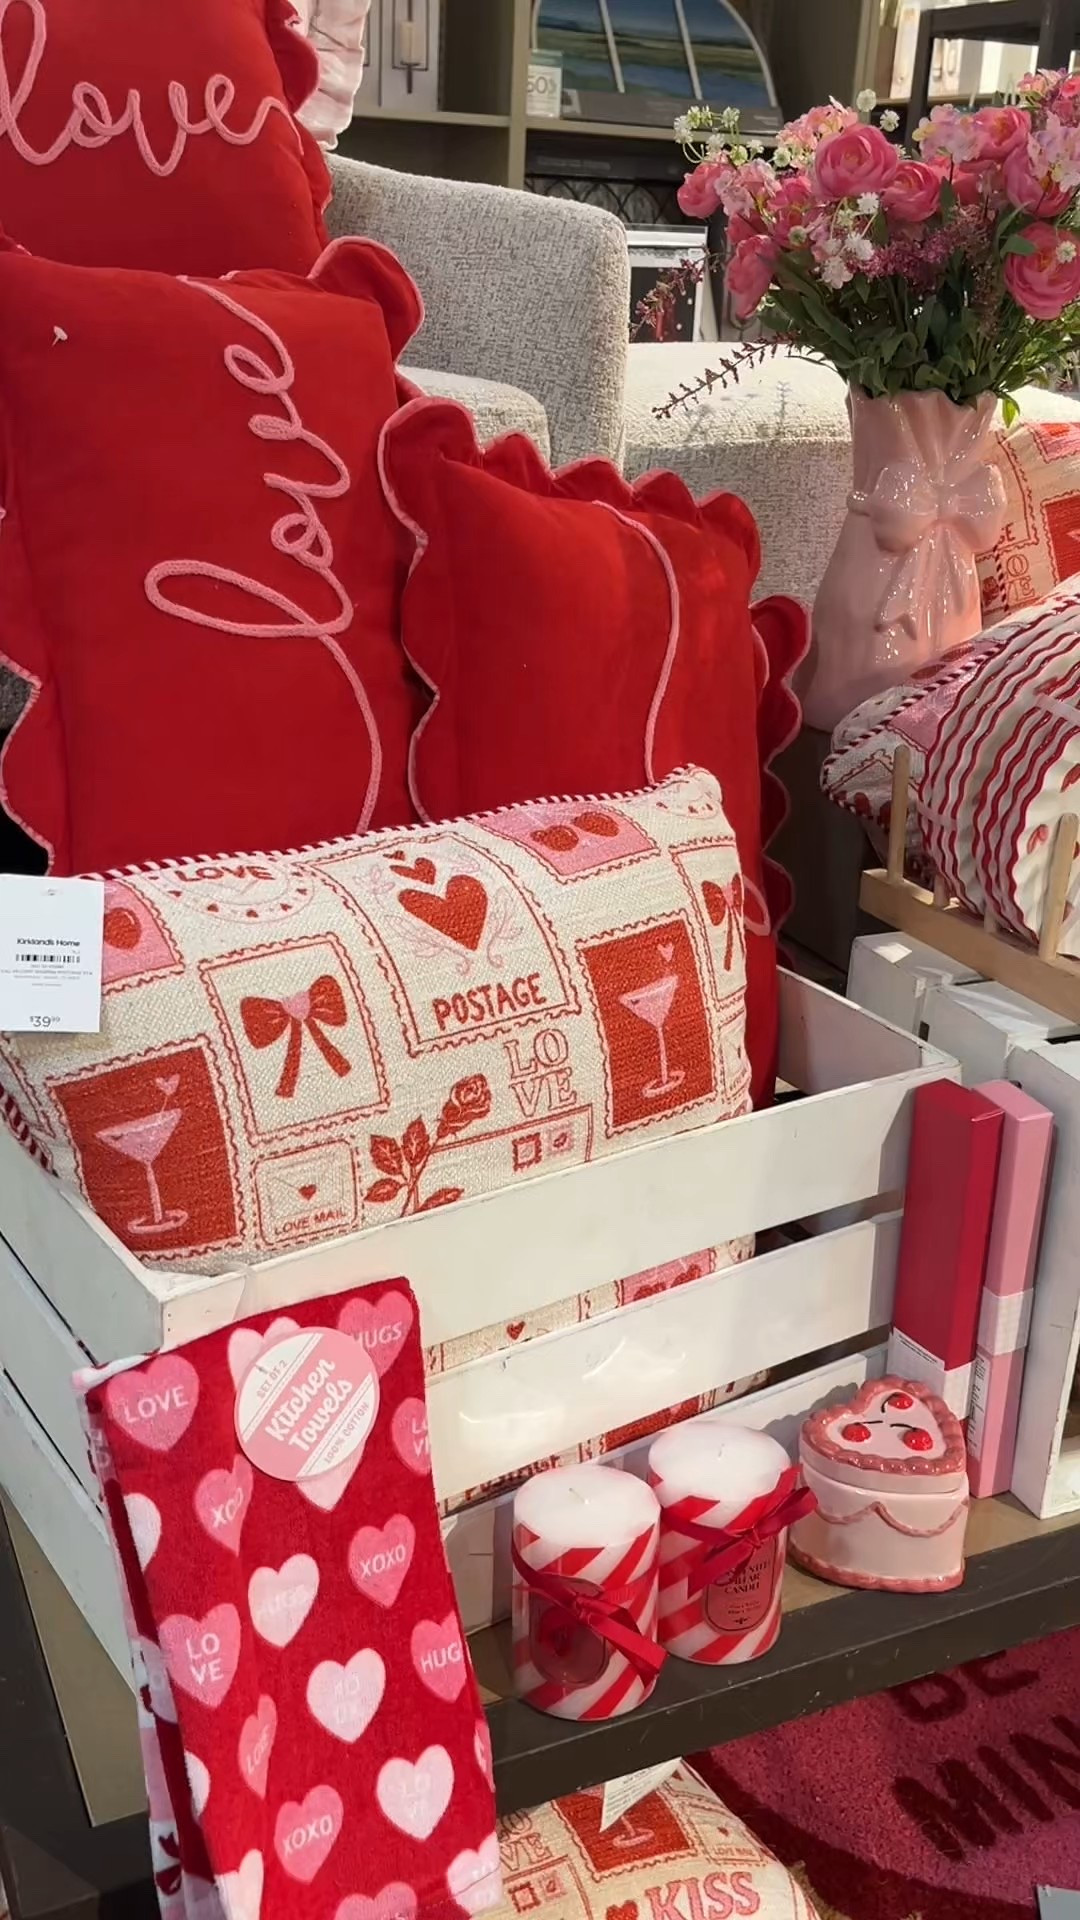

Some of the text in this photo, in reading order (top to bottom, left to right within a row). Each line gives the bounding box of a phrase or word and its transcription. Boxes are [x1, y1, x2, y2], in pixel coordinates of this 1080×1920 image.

[0, 0, 304, 176] love
[145, 275, 360, 650] love
[174, 864, 276, 882] LOVE
[55, 939, 81, 947] Home
[432, 972, 547, 1031] POSTAGE
[503, 1028, 569, 1079] LO
[509, 1066, 577, 1117] VE
[274, 1208, 347, 1236] LOVE MAIL
[122, 1384, 190, 1424] LOVE
[265, 1358, 336, 1442] Kitchen
[288, 1379, 353, 1452] Towels
[325, 1401, 370, 1465] 100% COTTON
[359, 1543, 406, 1580] XOXO
[185, 1633, 221, 1661] LO
[420, 1636, 464, 1674] HUG
[189, 1658, 224, 1686] VE
[281, 1813, 334, 1857] XOXO
[644, 1871, 762, 1920] KISS
